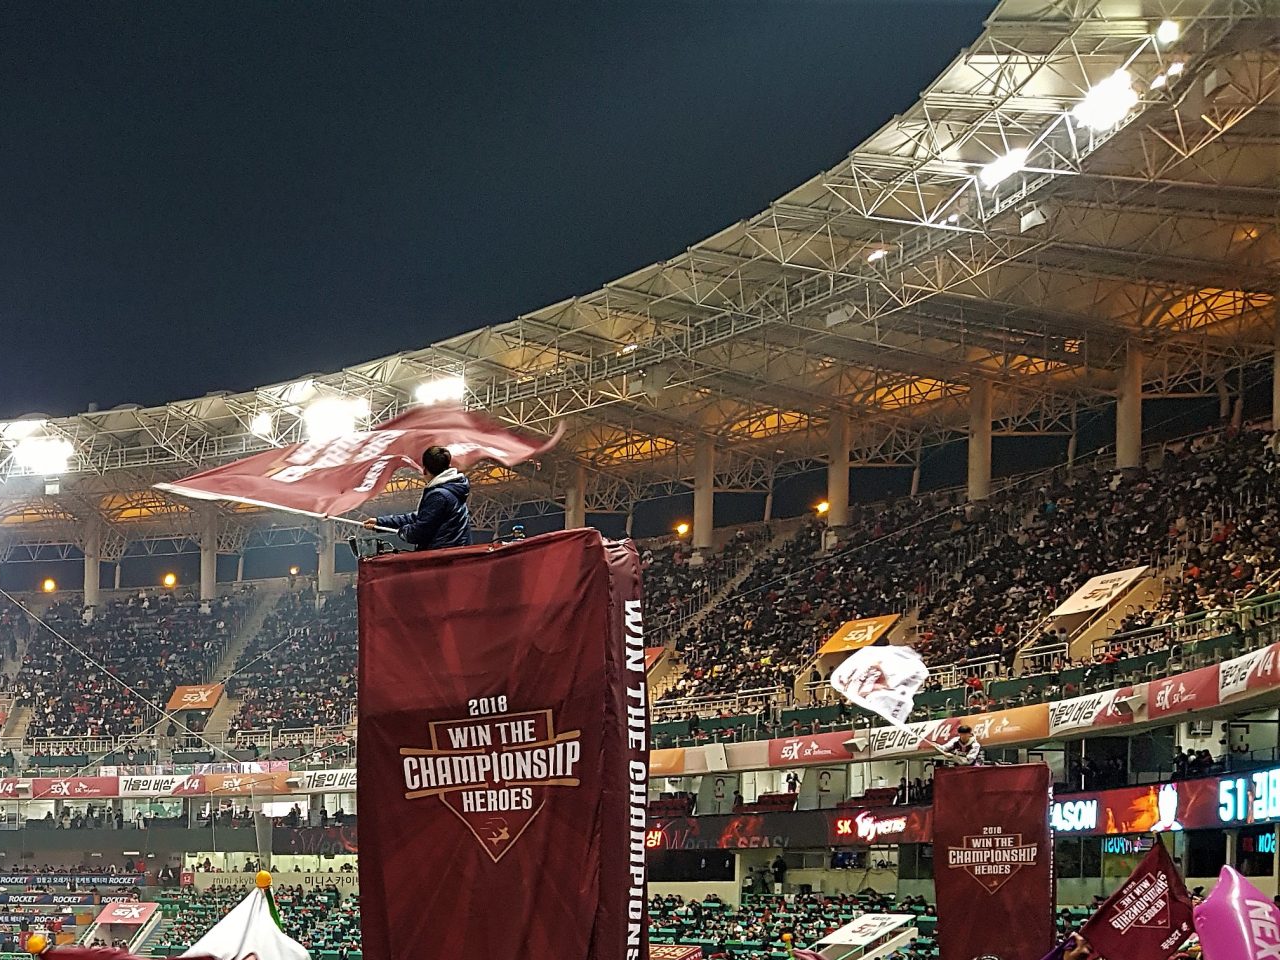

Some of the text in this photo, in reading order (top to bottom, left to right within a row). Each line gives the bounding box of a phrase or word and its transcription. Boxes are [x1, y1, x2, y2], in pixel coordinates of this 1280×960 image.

[625, 600, 644, 672] WIN
[468, 695, 508, 716] 2018
[627, 683, 646, 751] THE
[447, 720, 537, 748] WIN THE
[931, 723, 950, 741] V4
[183, 778, 199, 790] V4
[461, 788, 533, 812] HEROES
[1219, 778, 1246, 822] 51
[837, 819, 852, 834] SK
[982, 826, 1002, 835] 2018
[972, 836, 1014, 848] WIN THE
[948, 847, 1037, 864] CHAMPIONSHIP
[974, 864, 1011, 875] HEROES
